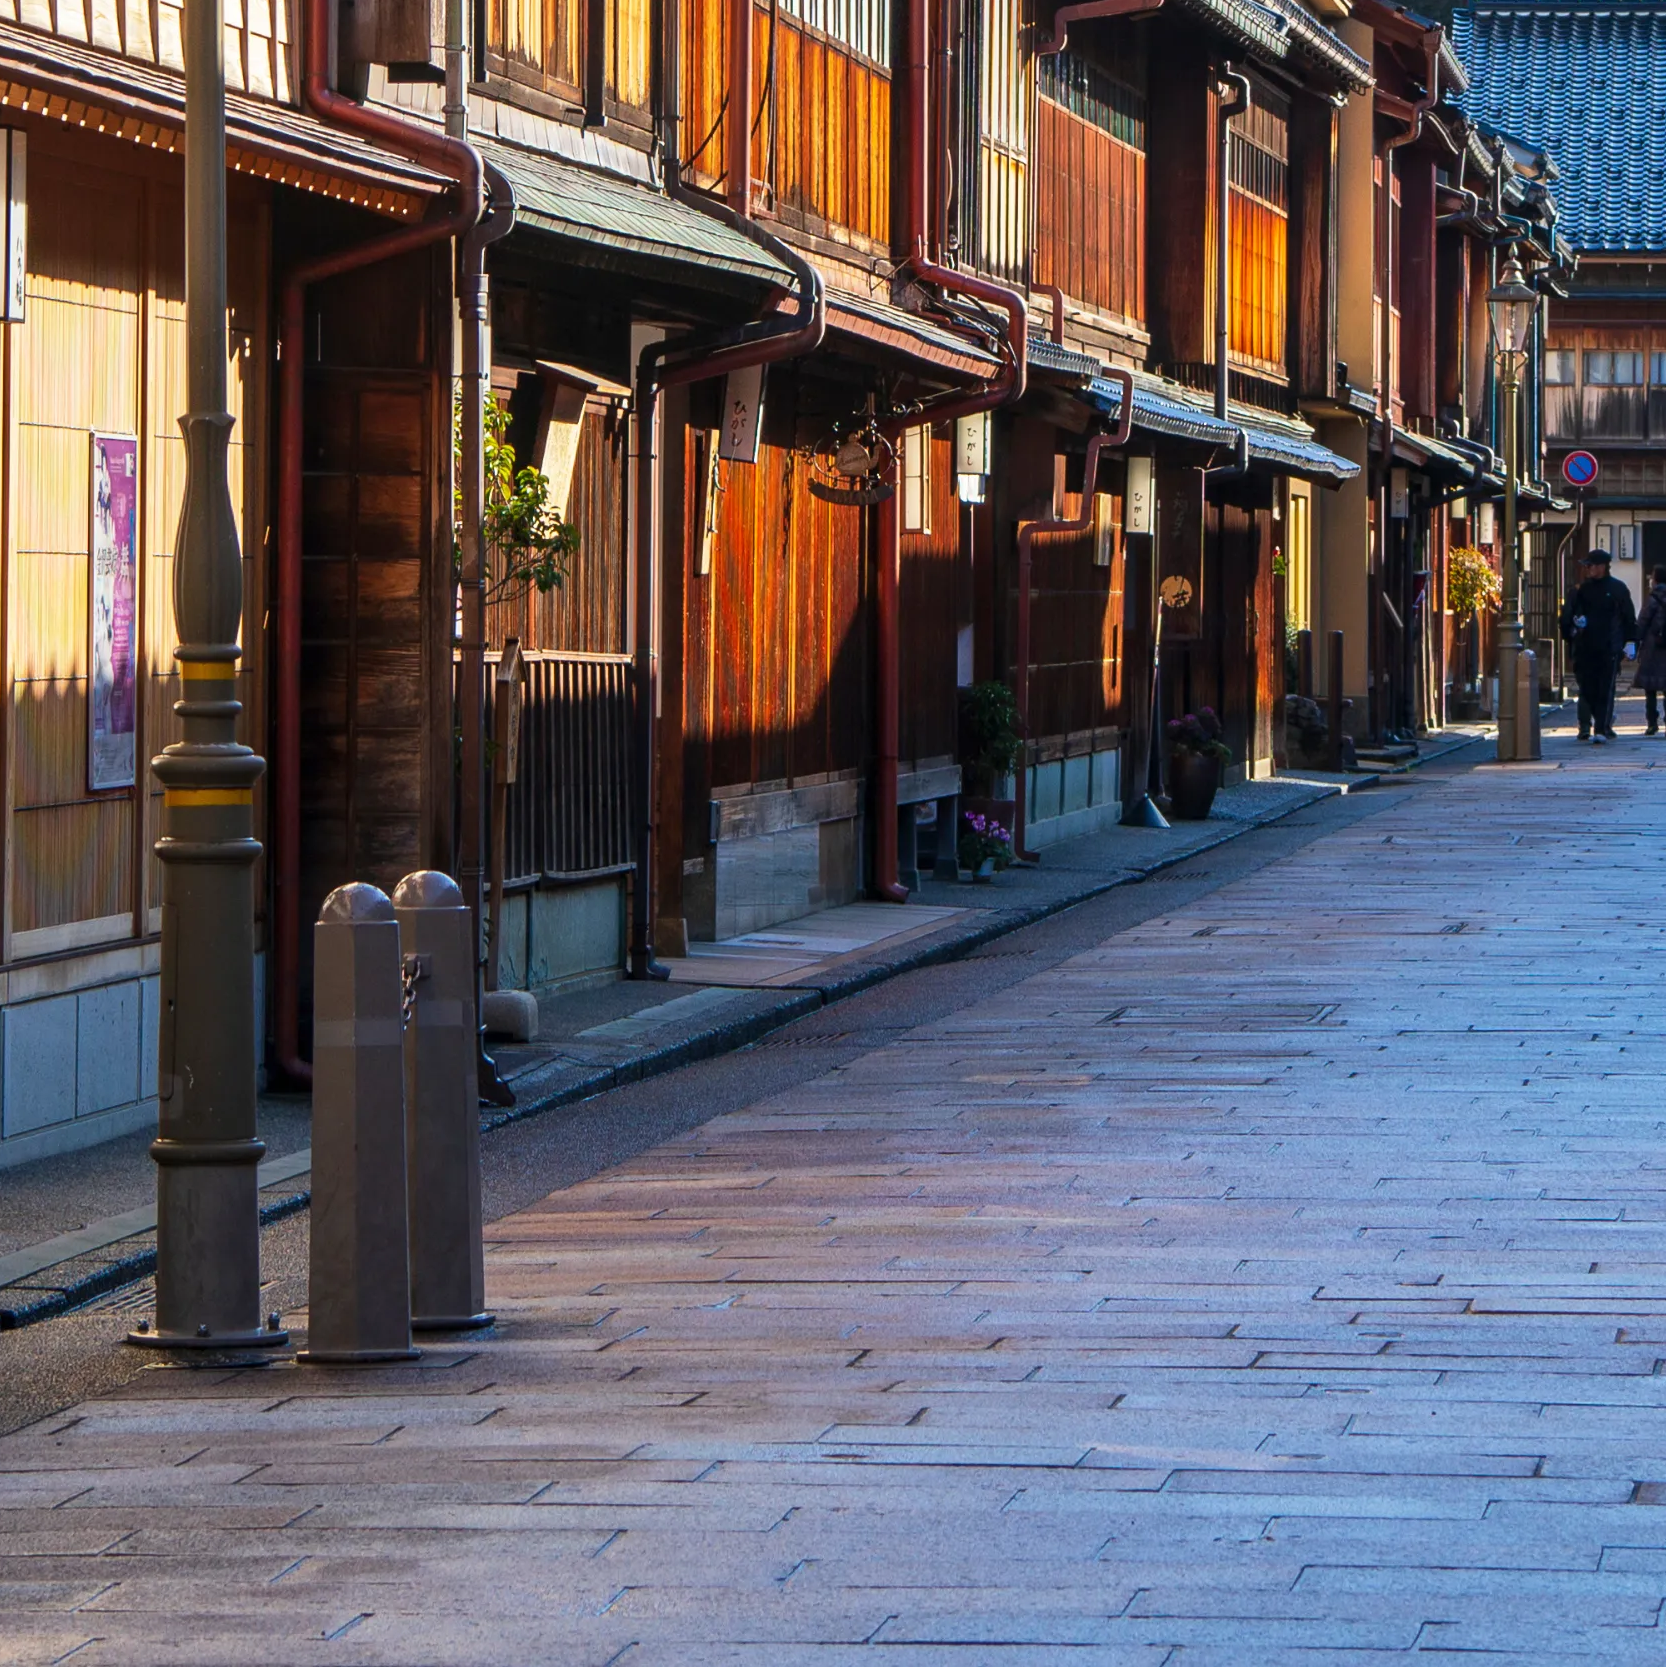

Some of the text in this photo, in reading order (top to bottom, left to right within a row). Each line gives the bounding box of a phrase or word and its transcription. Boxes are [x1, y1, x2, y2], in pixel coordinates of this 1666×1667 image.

[731, 400, 747, 447] ひがし
[966, 427, 977, 466] ひがし
[1133, 492, 1143, 527] ひがし
